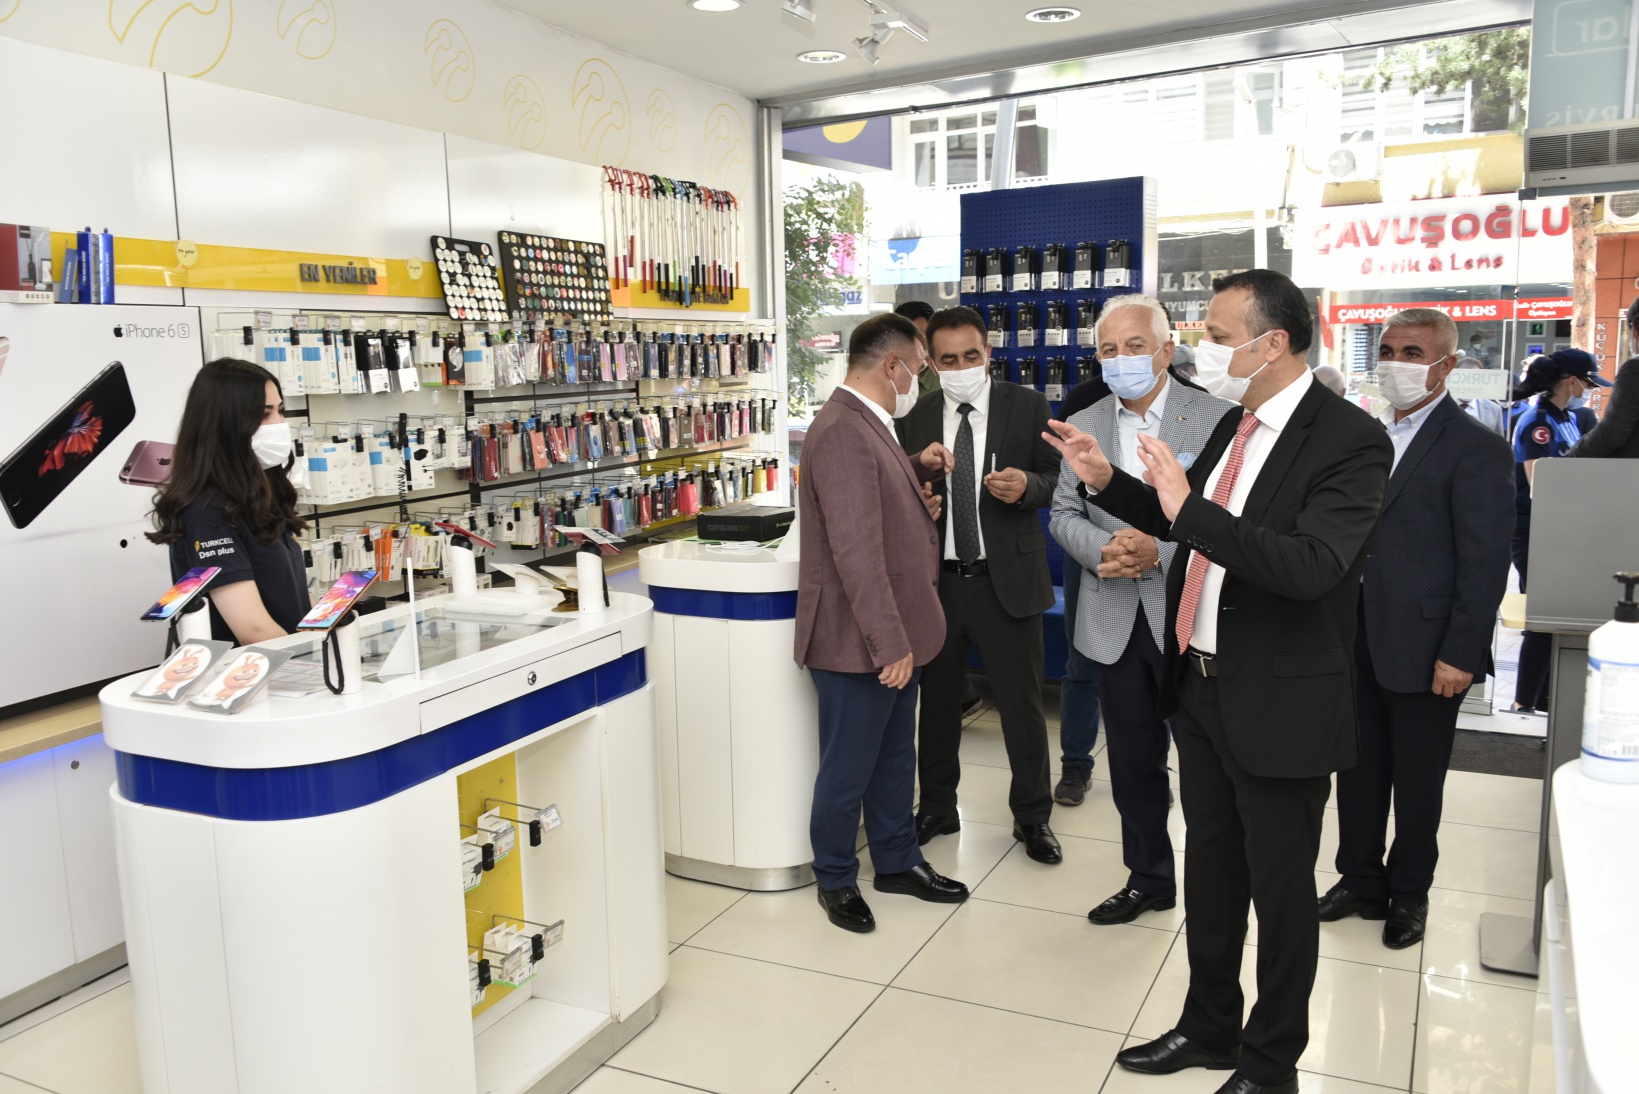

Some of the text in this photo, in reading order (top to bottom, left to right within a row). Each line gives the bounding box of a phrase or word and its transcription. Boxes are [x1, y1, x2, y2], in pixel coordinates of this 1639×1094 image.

[1450, 253, 1504, 271] Lens
[299, 263, 320, 282] EN
[1465, 305, 1497, 316] LENS
[125, 324, 166, 338] iPhone
[168, 324, 176, 338] 6
[201, 538, 234, 548] TURKCELL
[217, 546, 235, 556] plus
